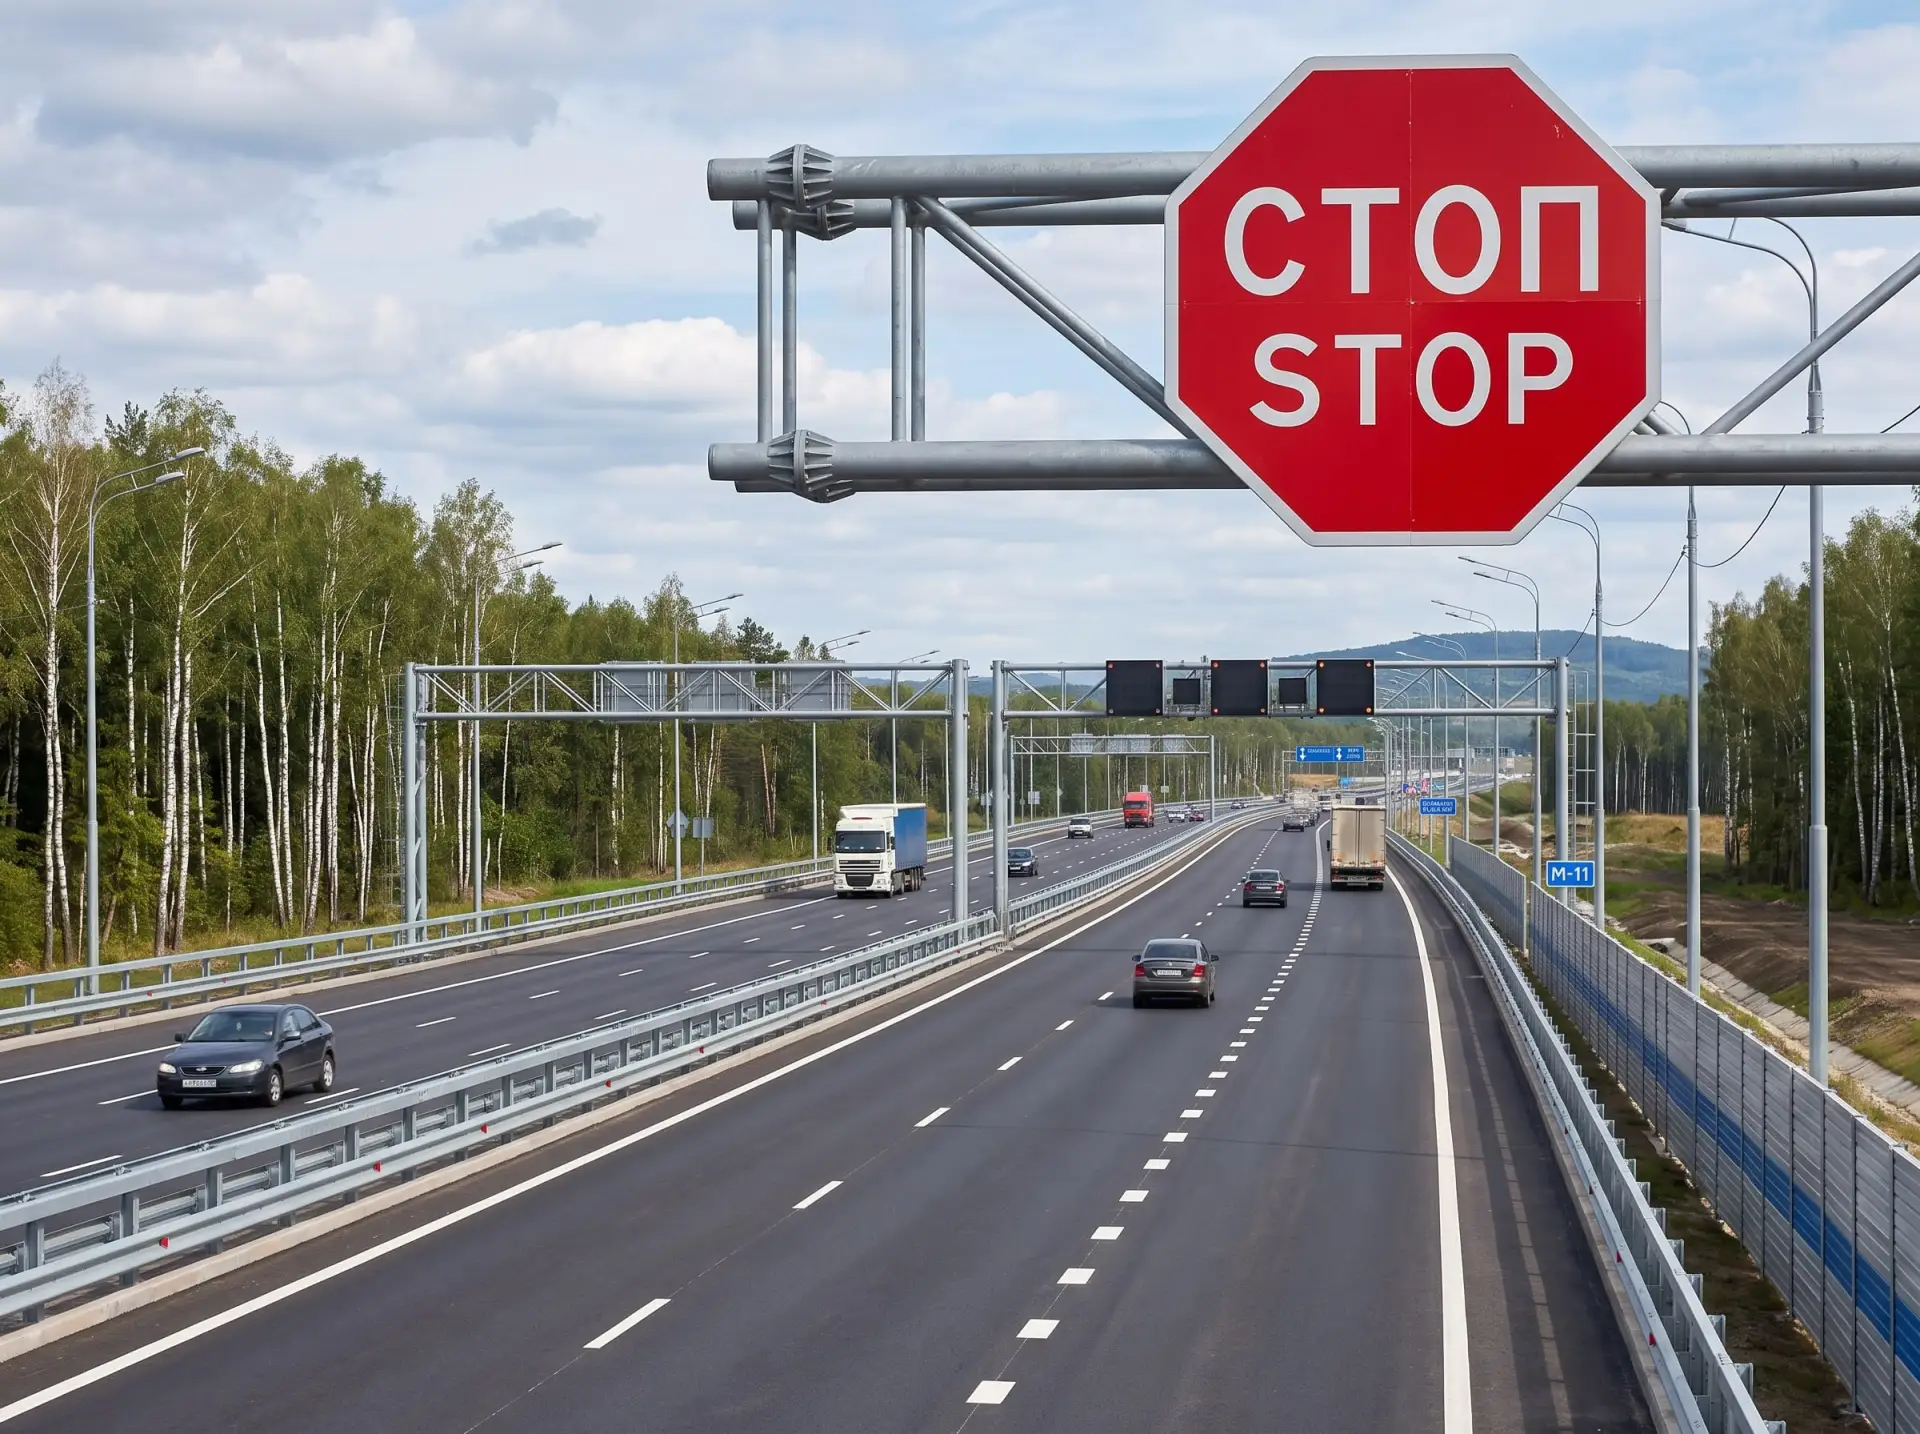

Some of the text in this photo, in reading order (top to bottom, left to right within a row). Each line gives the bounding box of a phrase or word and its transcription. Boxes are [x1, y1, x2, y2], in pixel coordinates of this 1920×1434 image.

[1224, 184, 1599, 297] СТОП
[1249, 331, 1574, 428] STOP
[1551, 866, 1589, 882] М-11
